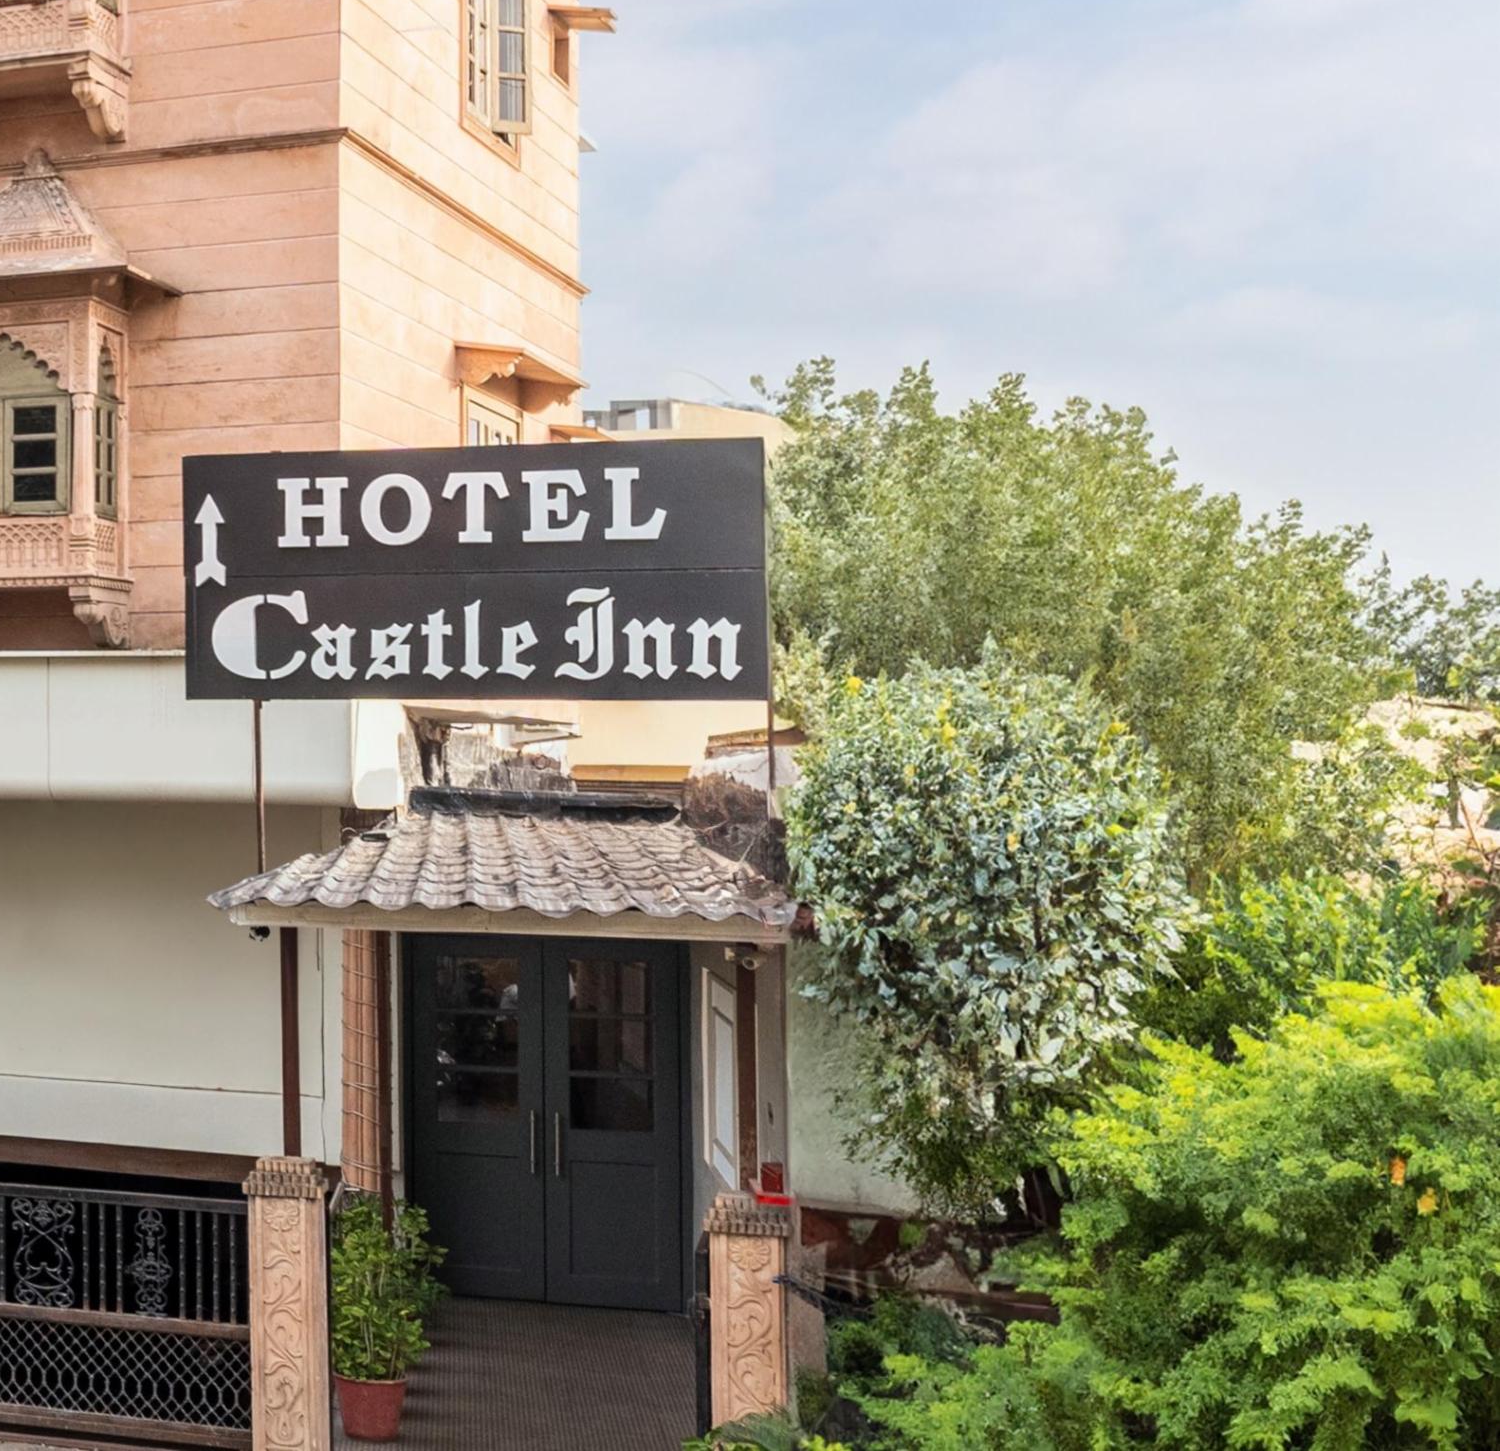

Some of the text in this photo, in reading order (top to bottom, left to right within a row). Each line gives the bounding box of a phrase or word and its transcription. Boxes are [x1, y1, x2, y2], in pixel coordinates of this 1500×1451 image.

[277, 467, 668, 548] HOTEL
[211, 586, 743, 681] Castle Inn
